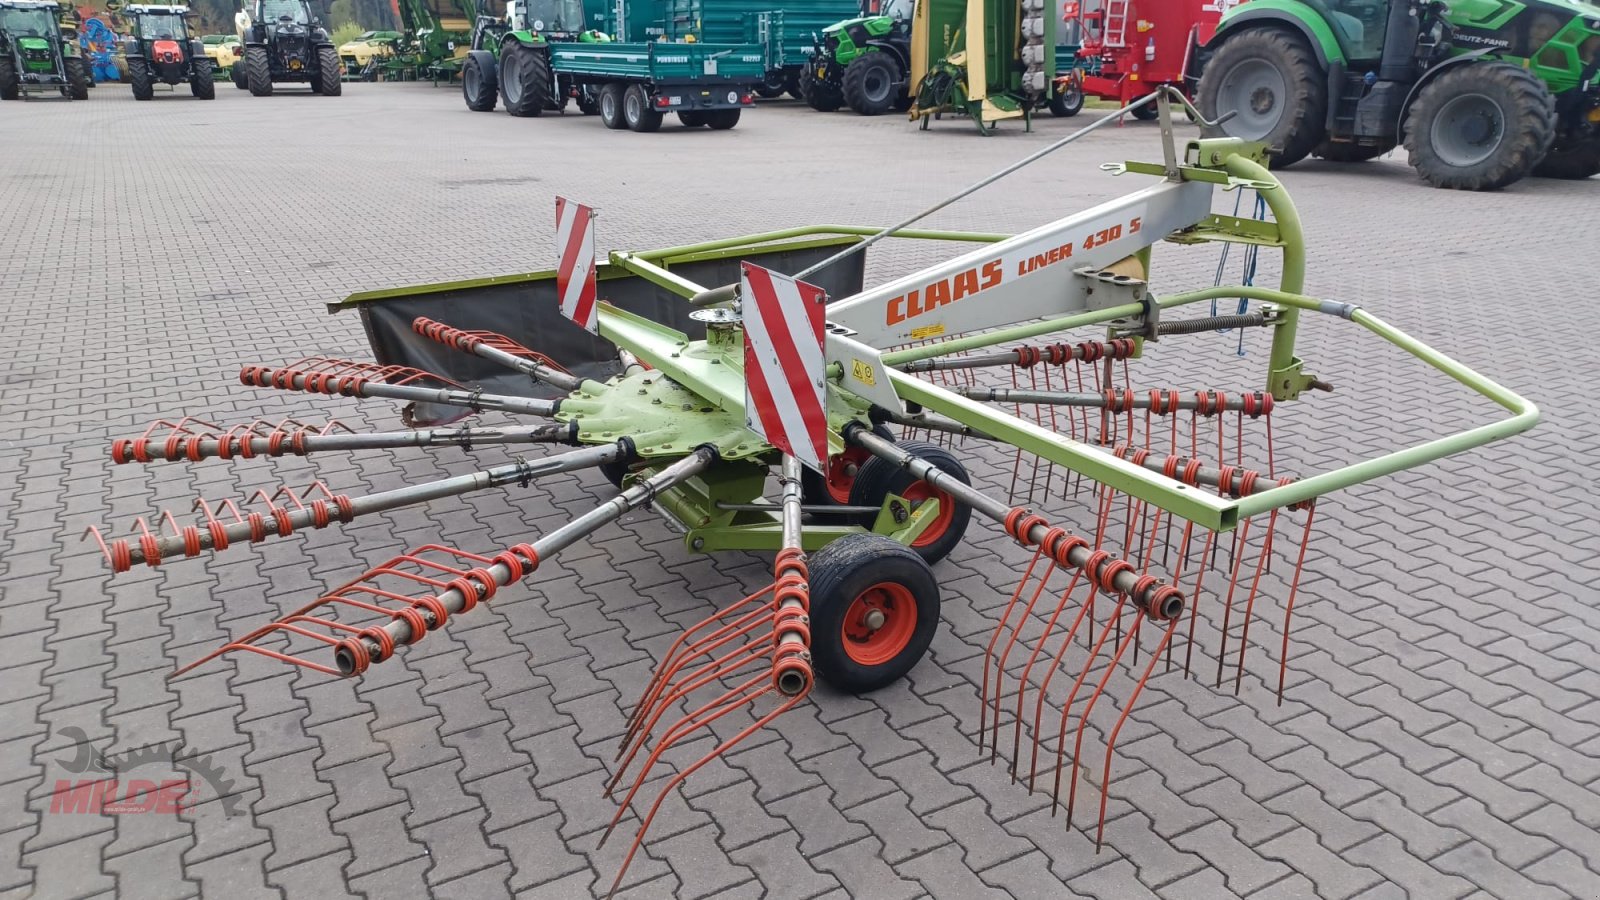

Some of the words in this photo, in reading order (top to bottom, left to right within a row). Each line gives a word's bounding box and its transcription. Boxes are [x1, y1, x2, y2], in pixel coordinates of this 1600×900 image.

[1453, 34, 1508, 47] DEUTZ-FAHR
[886, 258, 1002, 326] CLAAS
[1018, 242, 1073, 276] LINER
[1082, 224, 1122, 250] 430
[1129, 216, 1142, 234] S
